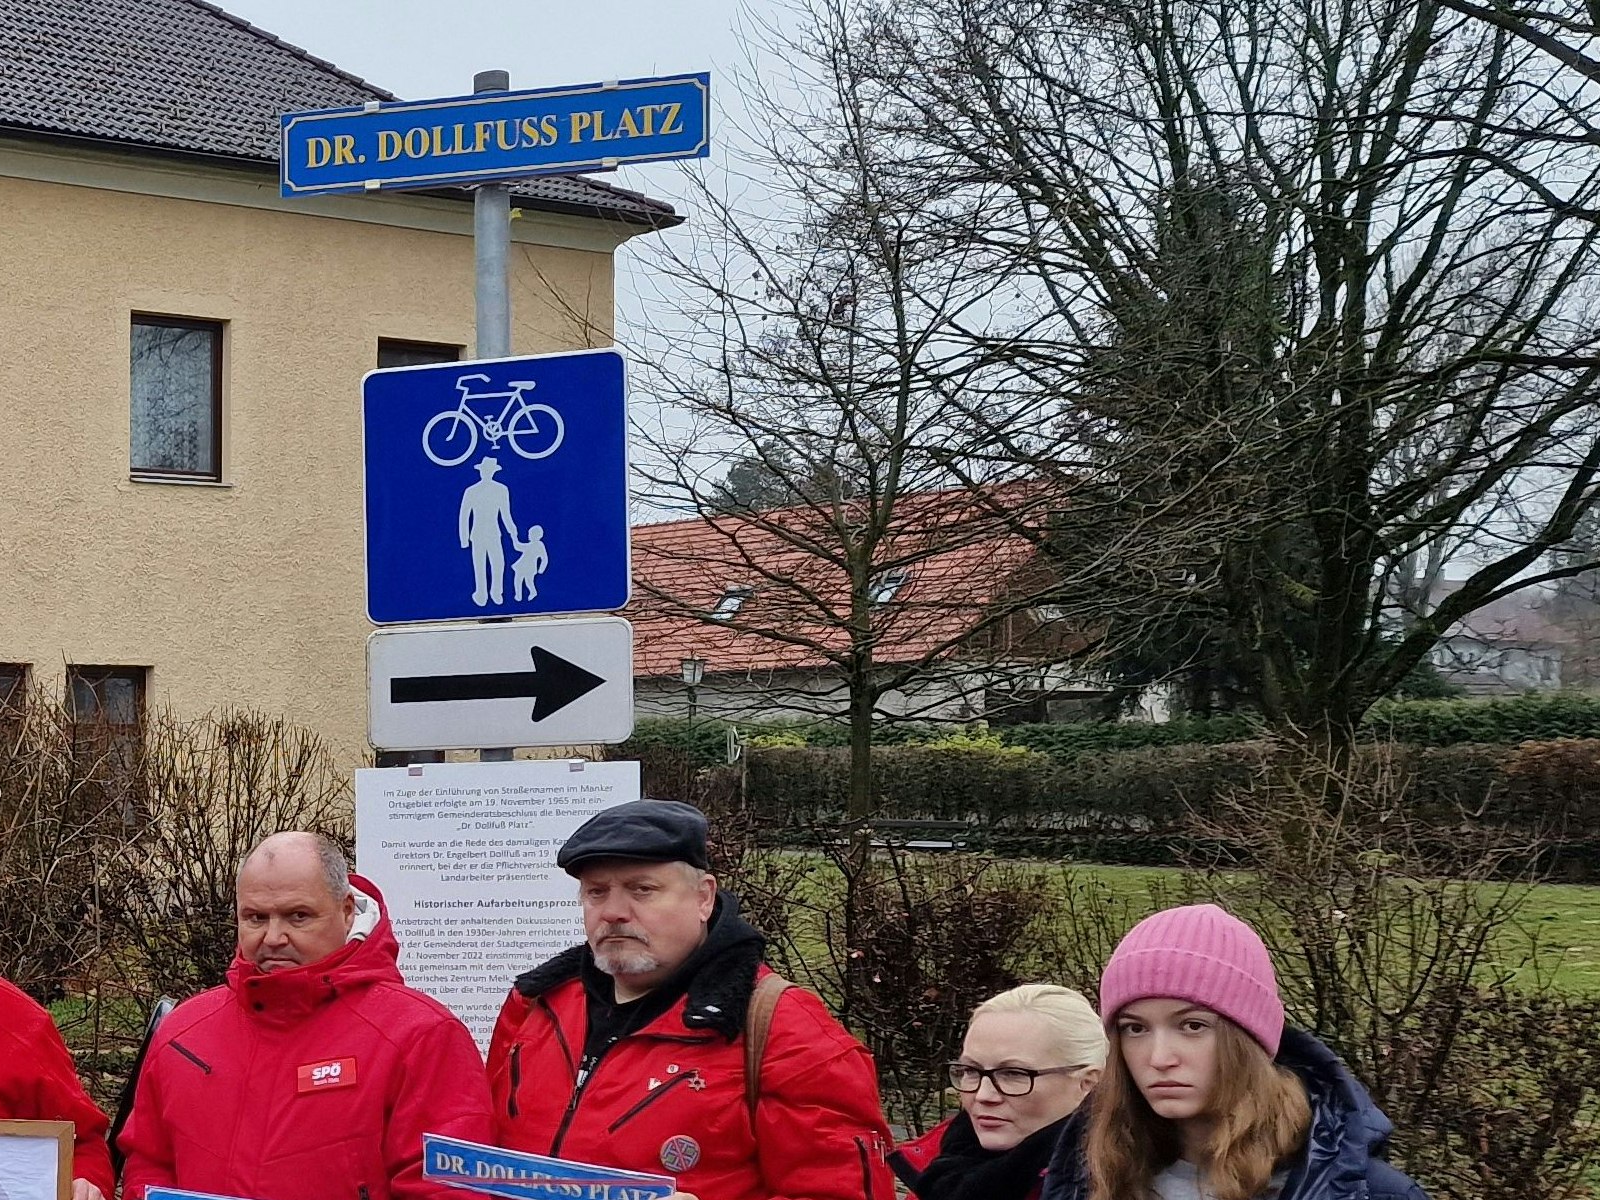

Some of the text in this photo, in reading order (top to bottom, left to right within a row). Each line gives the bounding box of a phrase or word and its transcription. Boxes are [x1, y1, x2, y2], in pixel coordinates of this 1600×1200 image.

[307, 102, 684, 168] DR. DOLLFUSS PLATZ
[447, 850, 487, 860] Engelbert
[440, 873, 494, 882] Landarbeiter
[414, 900, 474, 908] Historischer
[461, 917, 572, 926] anhaltenden Diskussionen
[466, 929, 526, 937] 1930er-Jahren
[423, 940, 561, 950] Gemeinderat Stadtgemeinde
[416, 952, 460, 960] November
[420, 964, 467, 972] gemeinsam
[312, 1062, 341, 1079] SPÖ
[436, 1152, 470, 1174] DR.
[476, 1161, 582, 1198] DOLLFUSS
